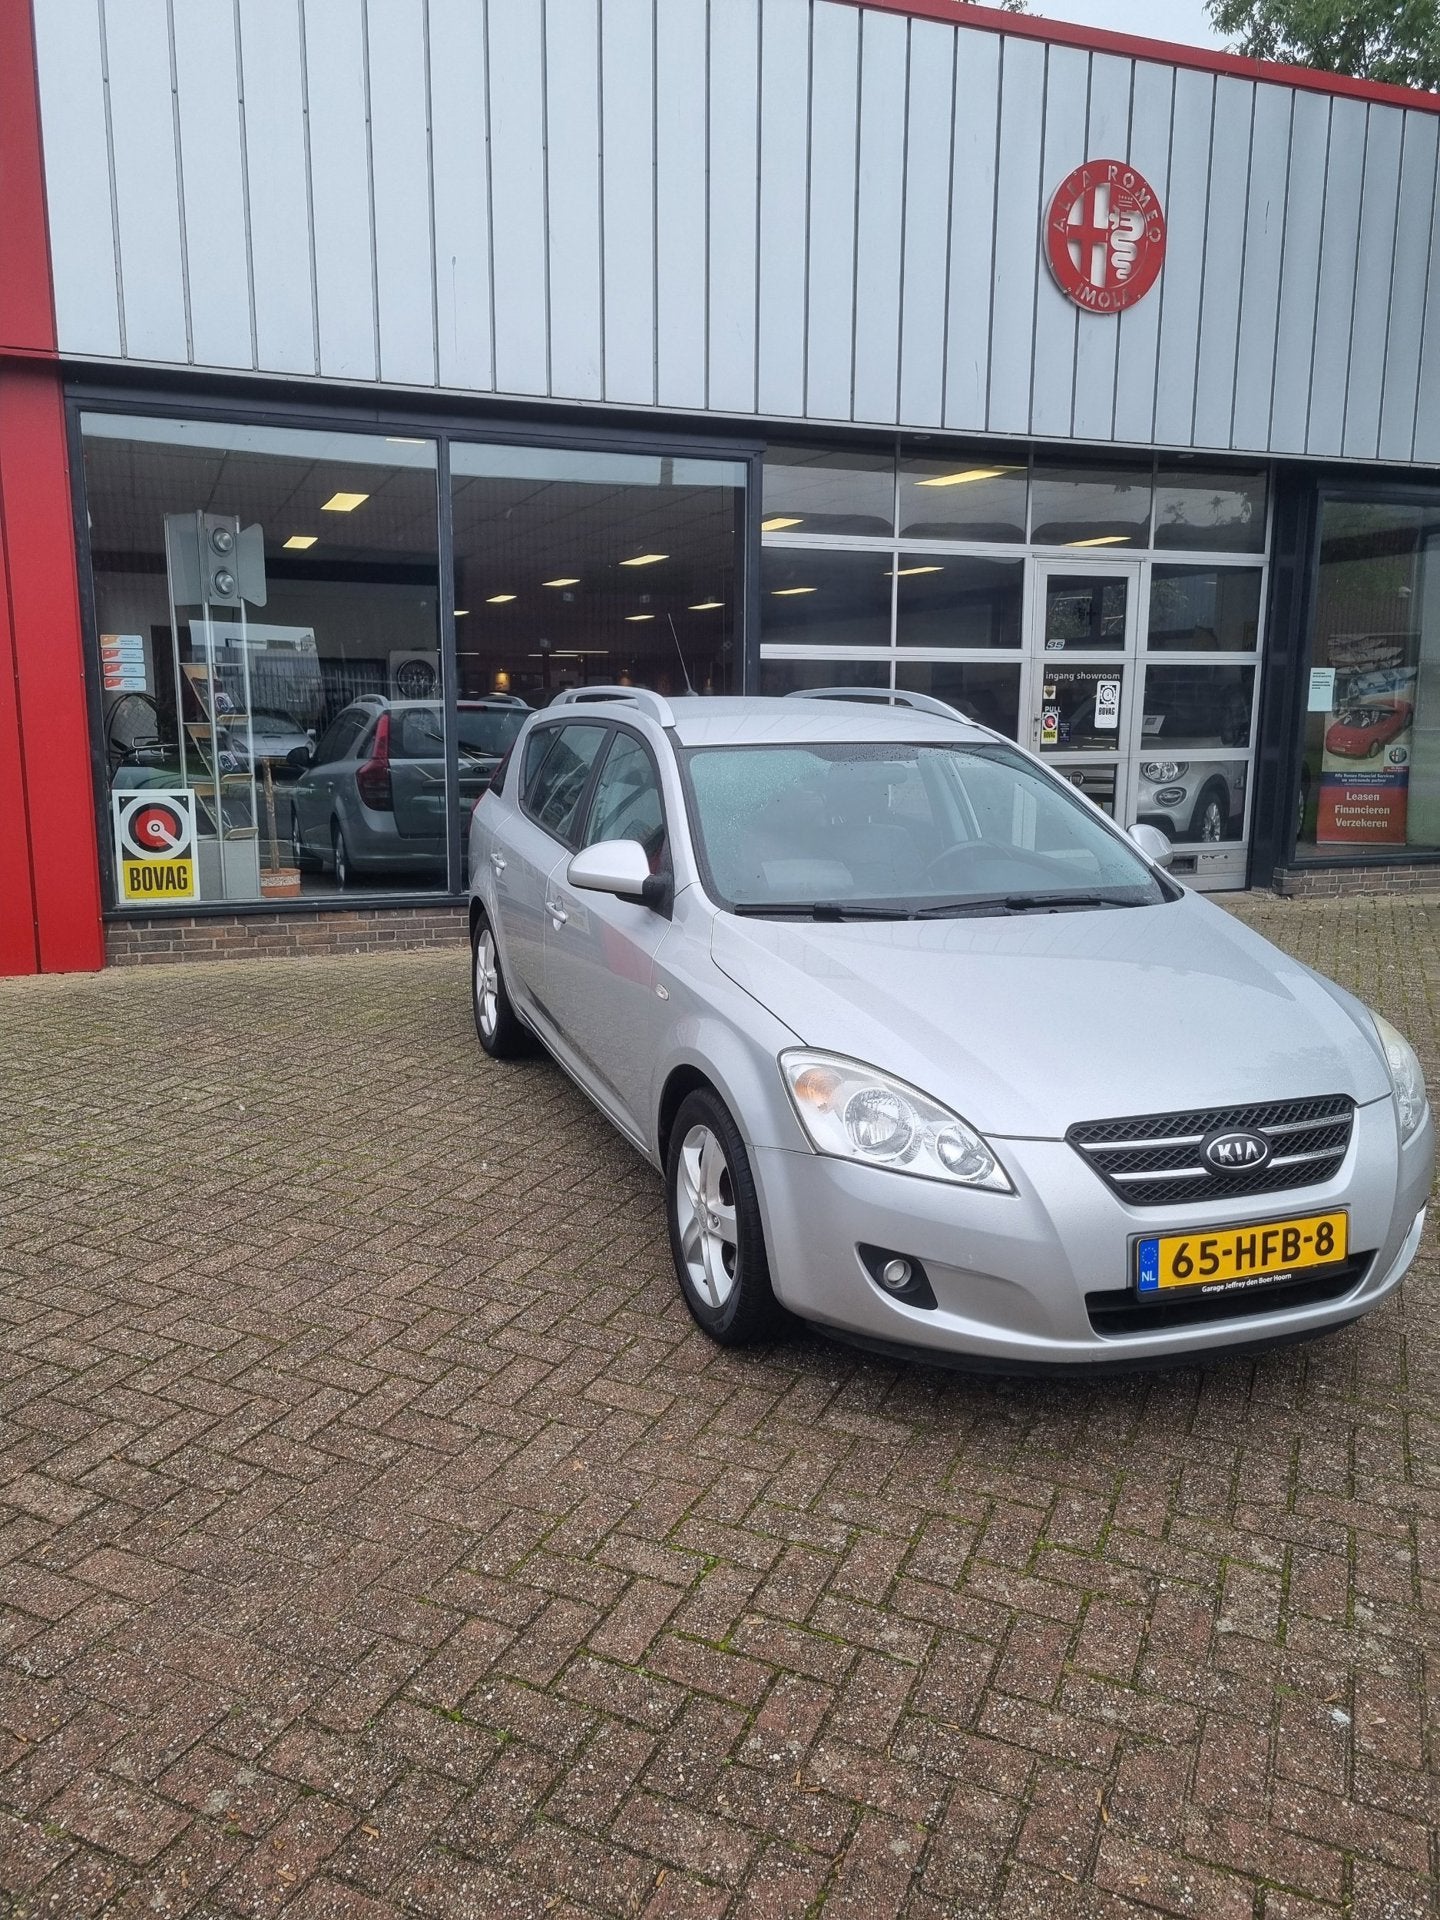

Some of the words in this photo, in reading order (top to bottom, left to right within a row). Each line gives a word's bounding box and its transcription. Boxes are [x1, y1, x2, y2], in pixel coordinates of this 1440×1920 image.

[1053, 170, 1092, 233] ALFA
[1107, 165, 1162, 243] ROMEO
[1046, 640, 1064, 649] 35
[1045, 672, 1075, 681] ingang
[1077, 671, 1120, 680] showroom
[1099, 707, 1115, 715] BOVAG
[1346, 791, 1380, 801] Leasen
[1334, 804, 1390, 815] Financieren
[1335, 817, 1388, 828] Verzekeren
[129, 865, 188, 892] BOVAG
[1217, 1141, 1260, 1163] KIA
[1141, 1270, 1156, 1282] NL
[1171, 1221, 1335, 1279] 65-HFB-8
[1201, 1284, 1225, 1293] Garage
[1224, 1281, 1246, 1290] Jeffrey
[1246, 1279, 1258, 1287] den
[1258, 1276, 1273, 1284] Boer
[1273, 1273, 1292, 1282] Hoorn
